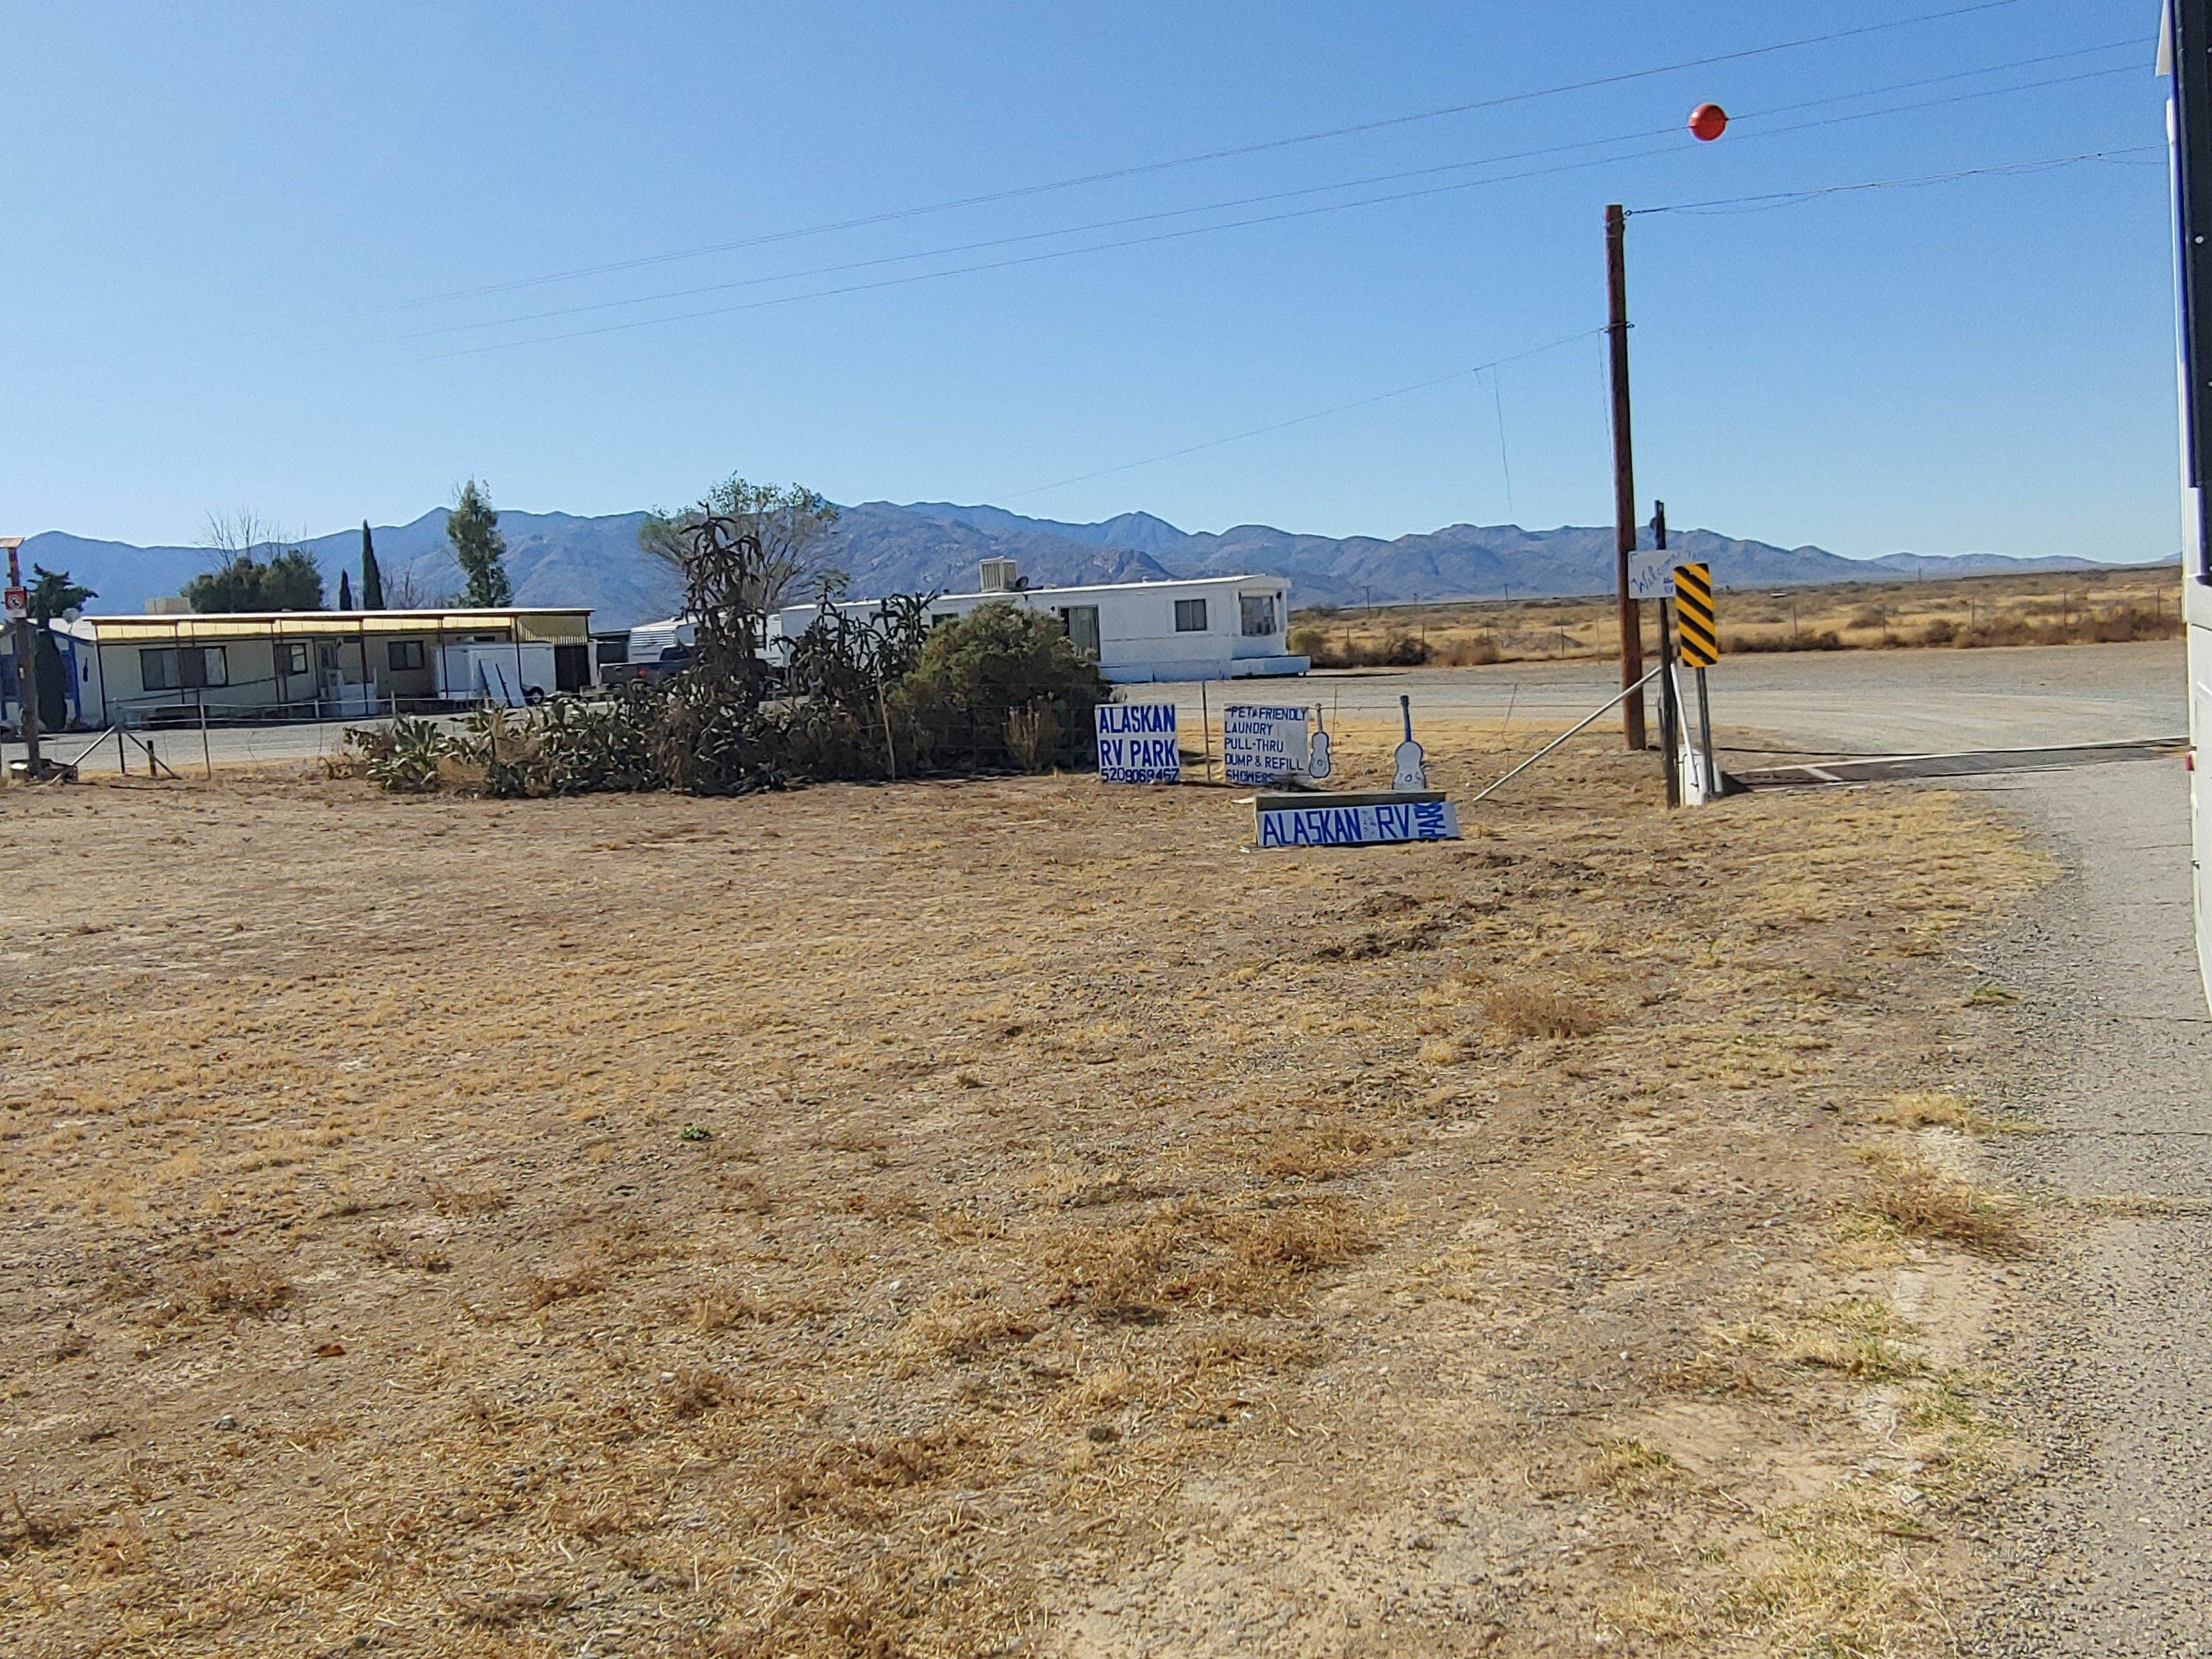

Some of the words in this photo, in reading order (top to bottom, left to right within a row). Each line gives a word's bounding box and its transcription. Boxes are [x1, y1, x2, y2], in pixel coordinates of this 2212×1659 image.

[1099, 705, 1176, 733] ALASKAN
[1225, 721, 1274, 736] LAUNDRY
[1100, 739, 1123, 767] RV
[1130, 739, 1177, 767] PARK
[1225, 737, 1284, 753] PULL-THRU
[1225, 753, 1253, 767] DUMP
[1254, 755, 1262, 767] &
[1265, 756, 1305, 771] REFILL
[1226, 769, 1275, 783] SHOWERS
[1263, 807, 1363, 846] ALASKAN
[1375, 804, 1410, 840] RV
[1413, 802, 1448, 838] PARK
